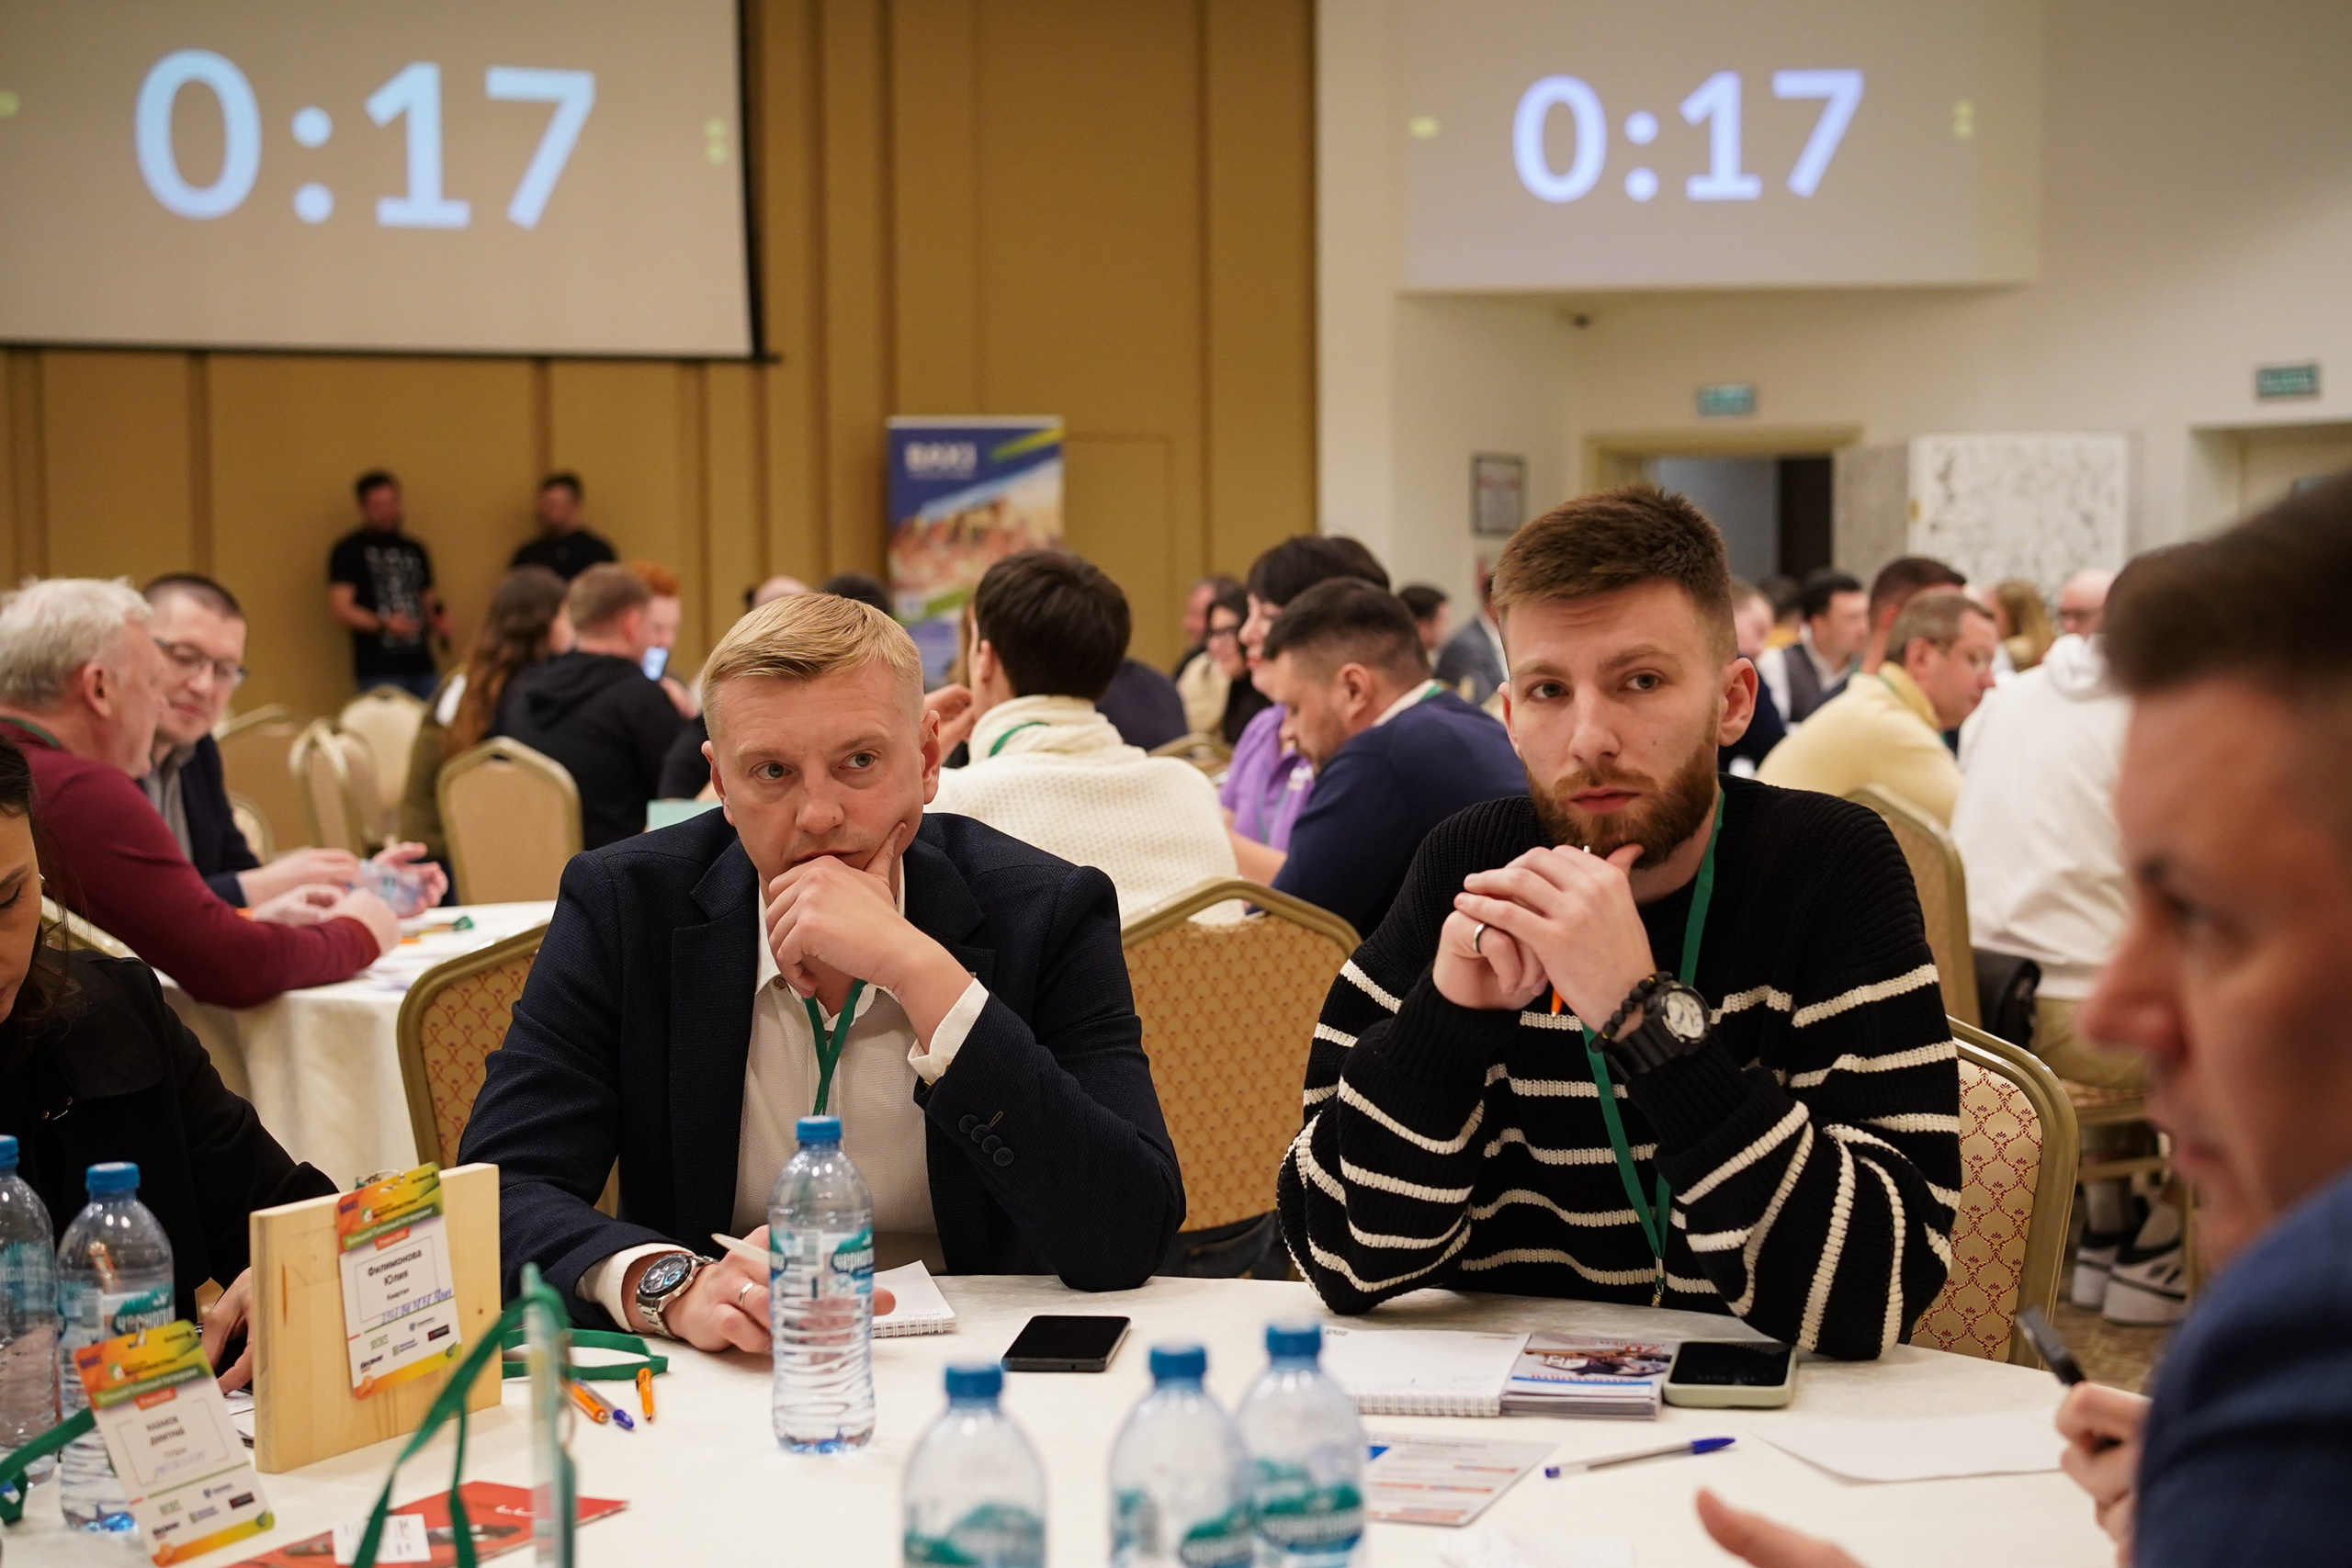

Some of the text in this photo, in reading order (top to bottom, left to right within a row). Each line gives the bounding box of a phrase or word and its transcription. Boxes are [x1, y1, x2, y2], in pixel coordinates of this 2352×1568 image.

[134, 48, 597, 231] 0:17
[1511, 68, 1866, 204] 0:17
[384, 1269, 409, 1286] Юлия
